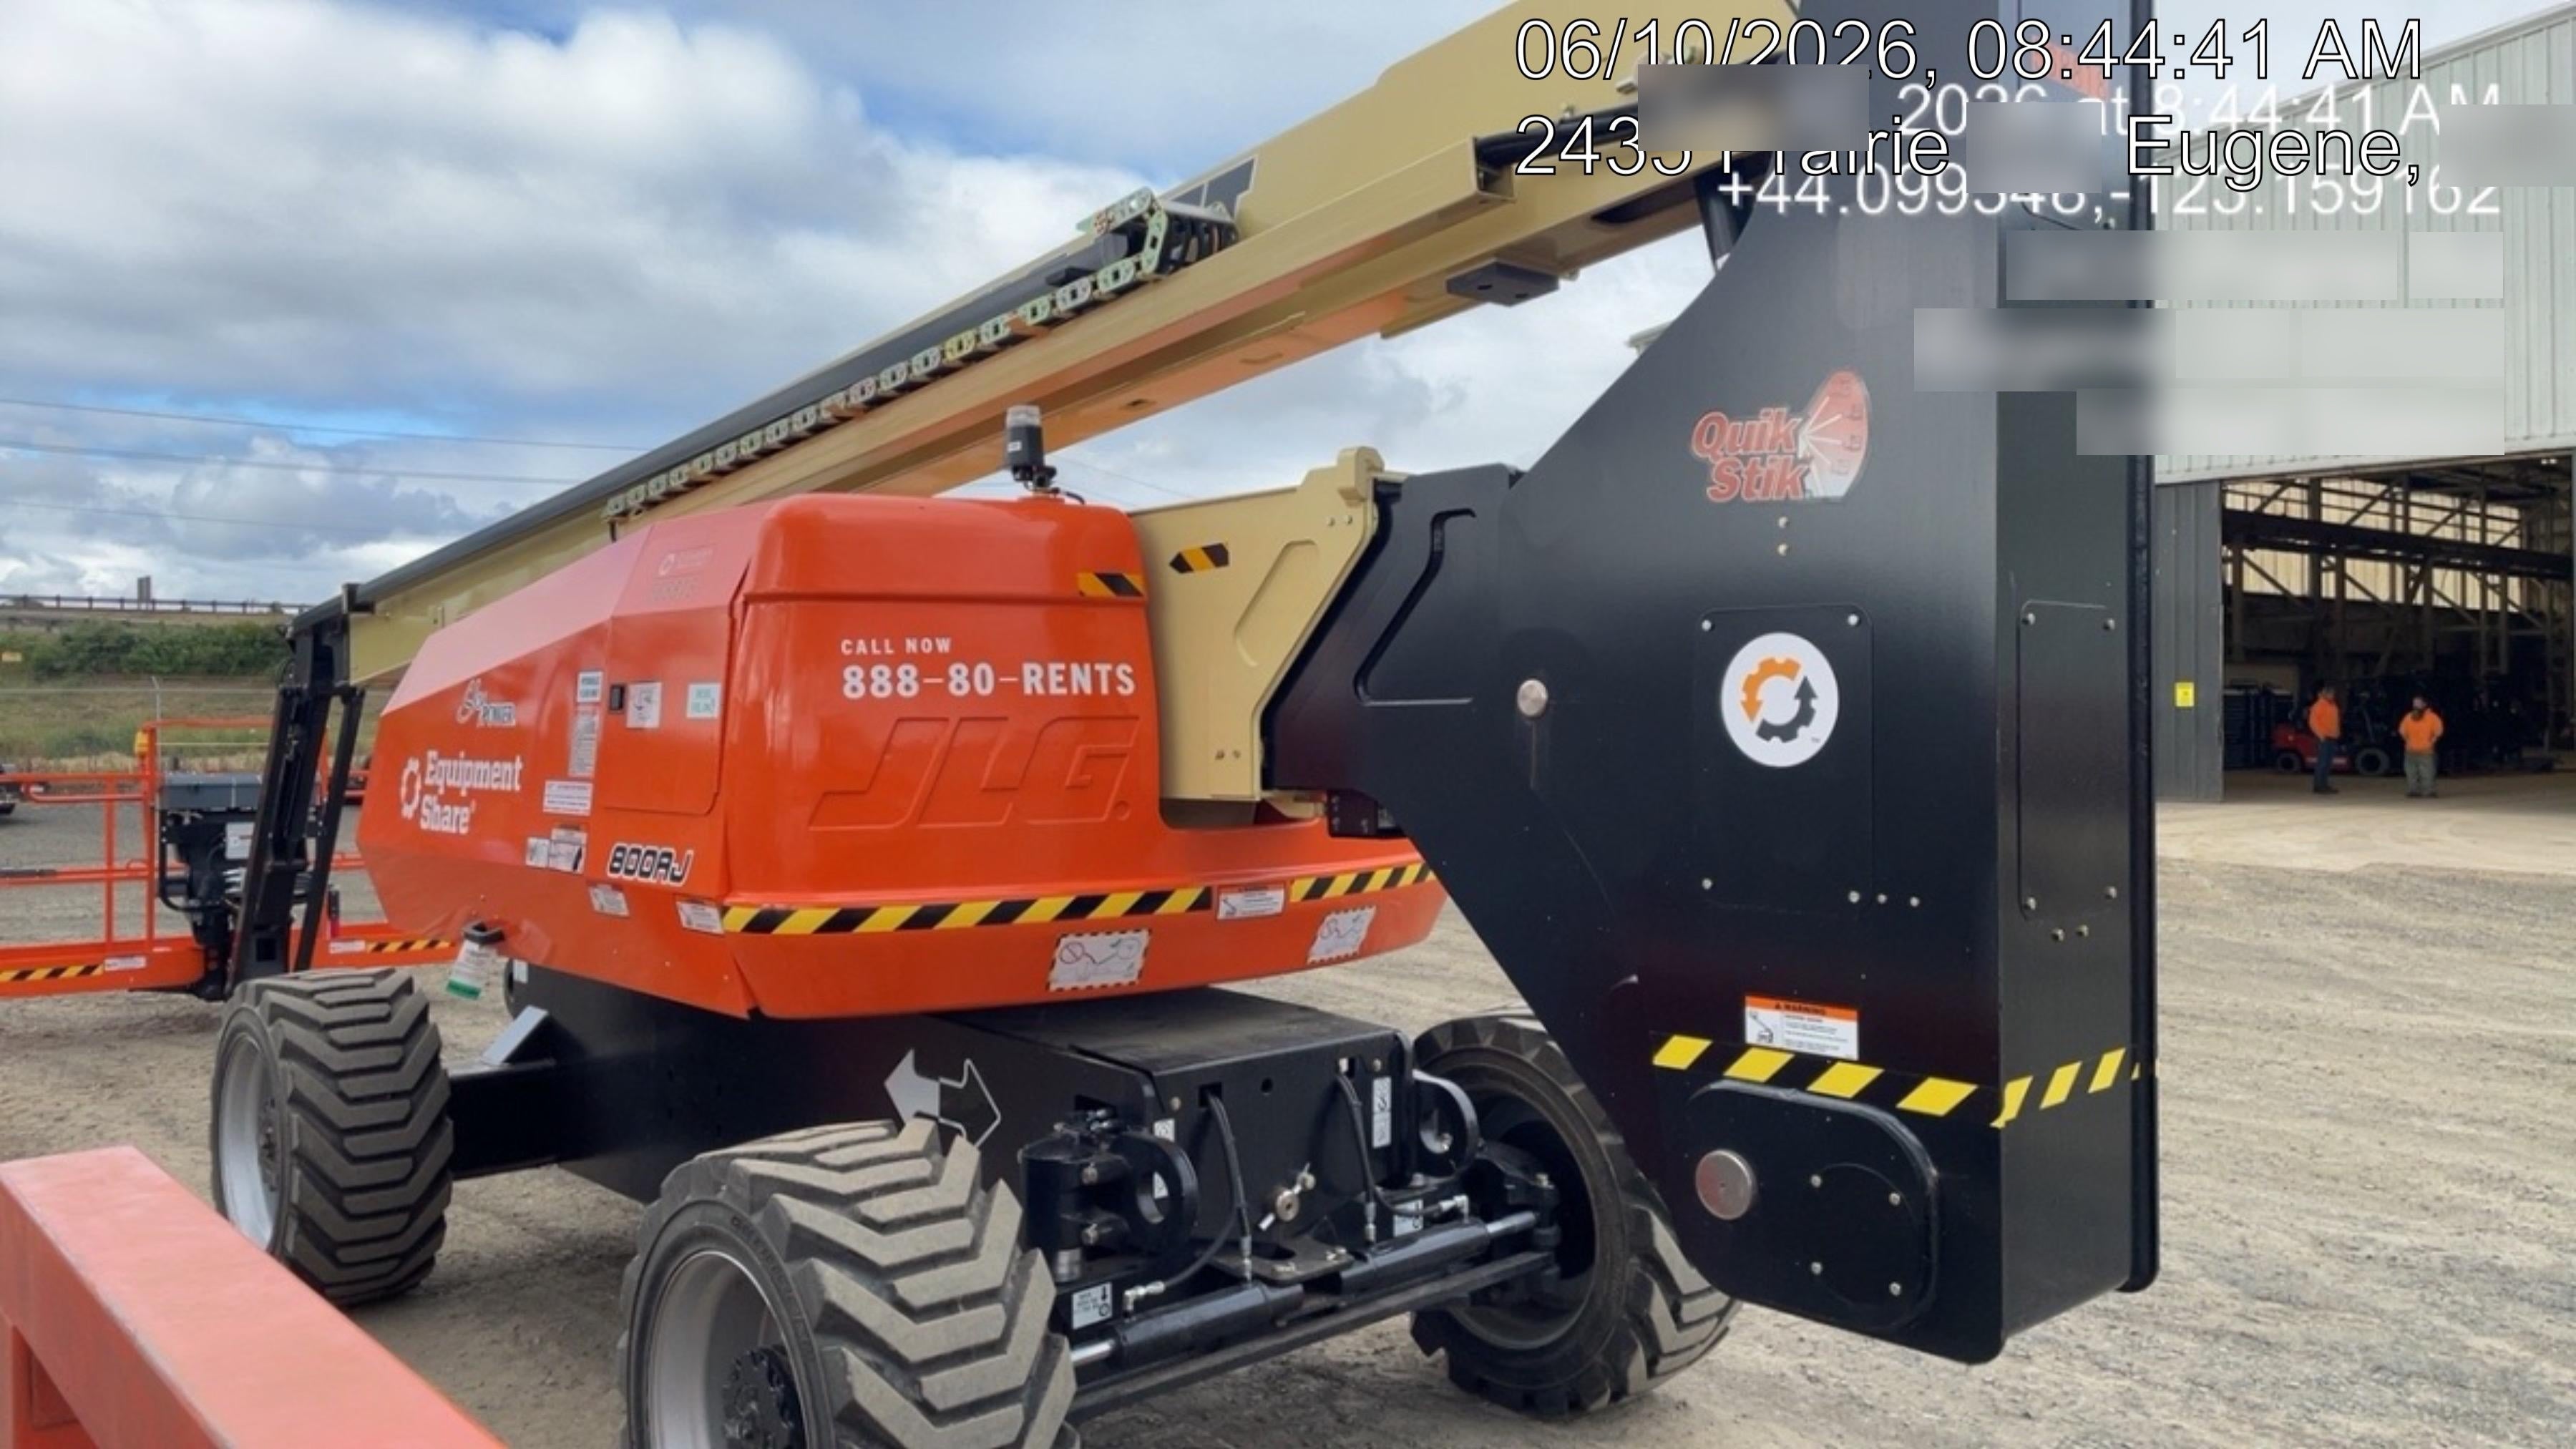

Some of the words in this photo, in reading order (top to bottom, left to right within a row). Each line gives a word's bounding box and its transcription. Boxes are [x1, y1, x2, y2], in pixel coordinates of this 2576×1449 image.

[1692, 407, 1802, 463] Quik
[1707, 457, 1810, 502] Stik
[840, 638, 895, 655] CALL
[905, 637, 952, 653] NOW
[842, 662, 1136, 699] 888-80-RENTS
[424, 750, 523, 797] Equipment
[608, 843, 693, 887] 800AJ
